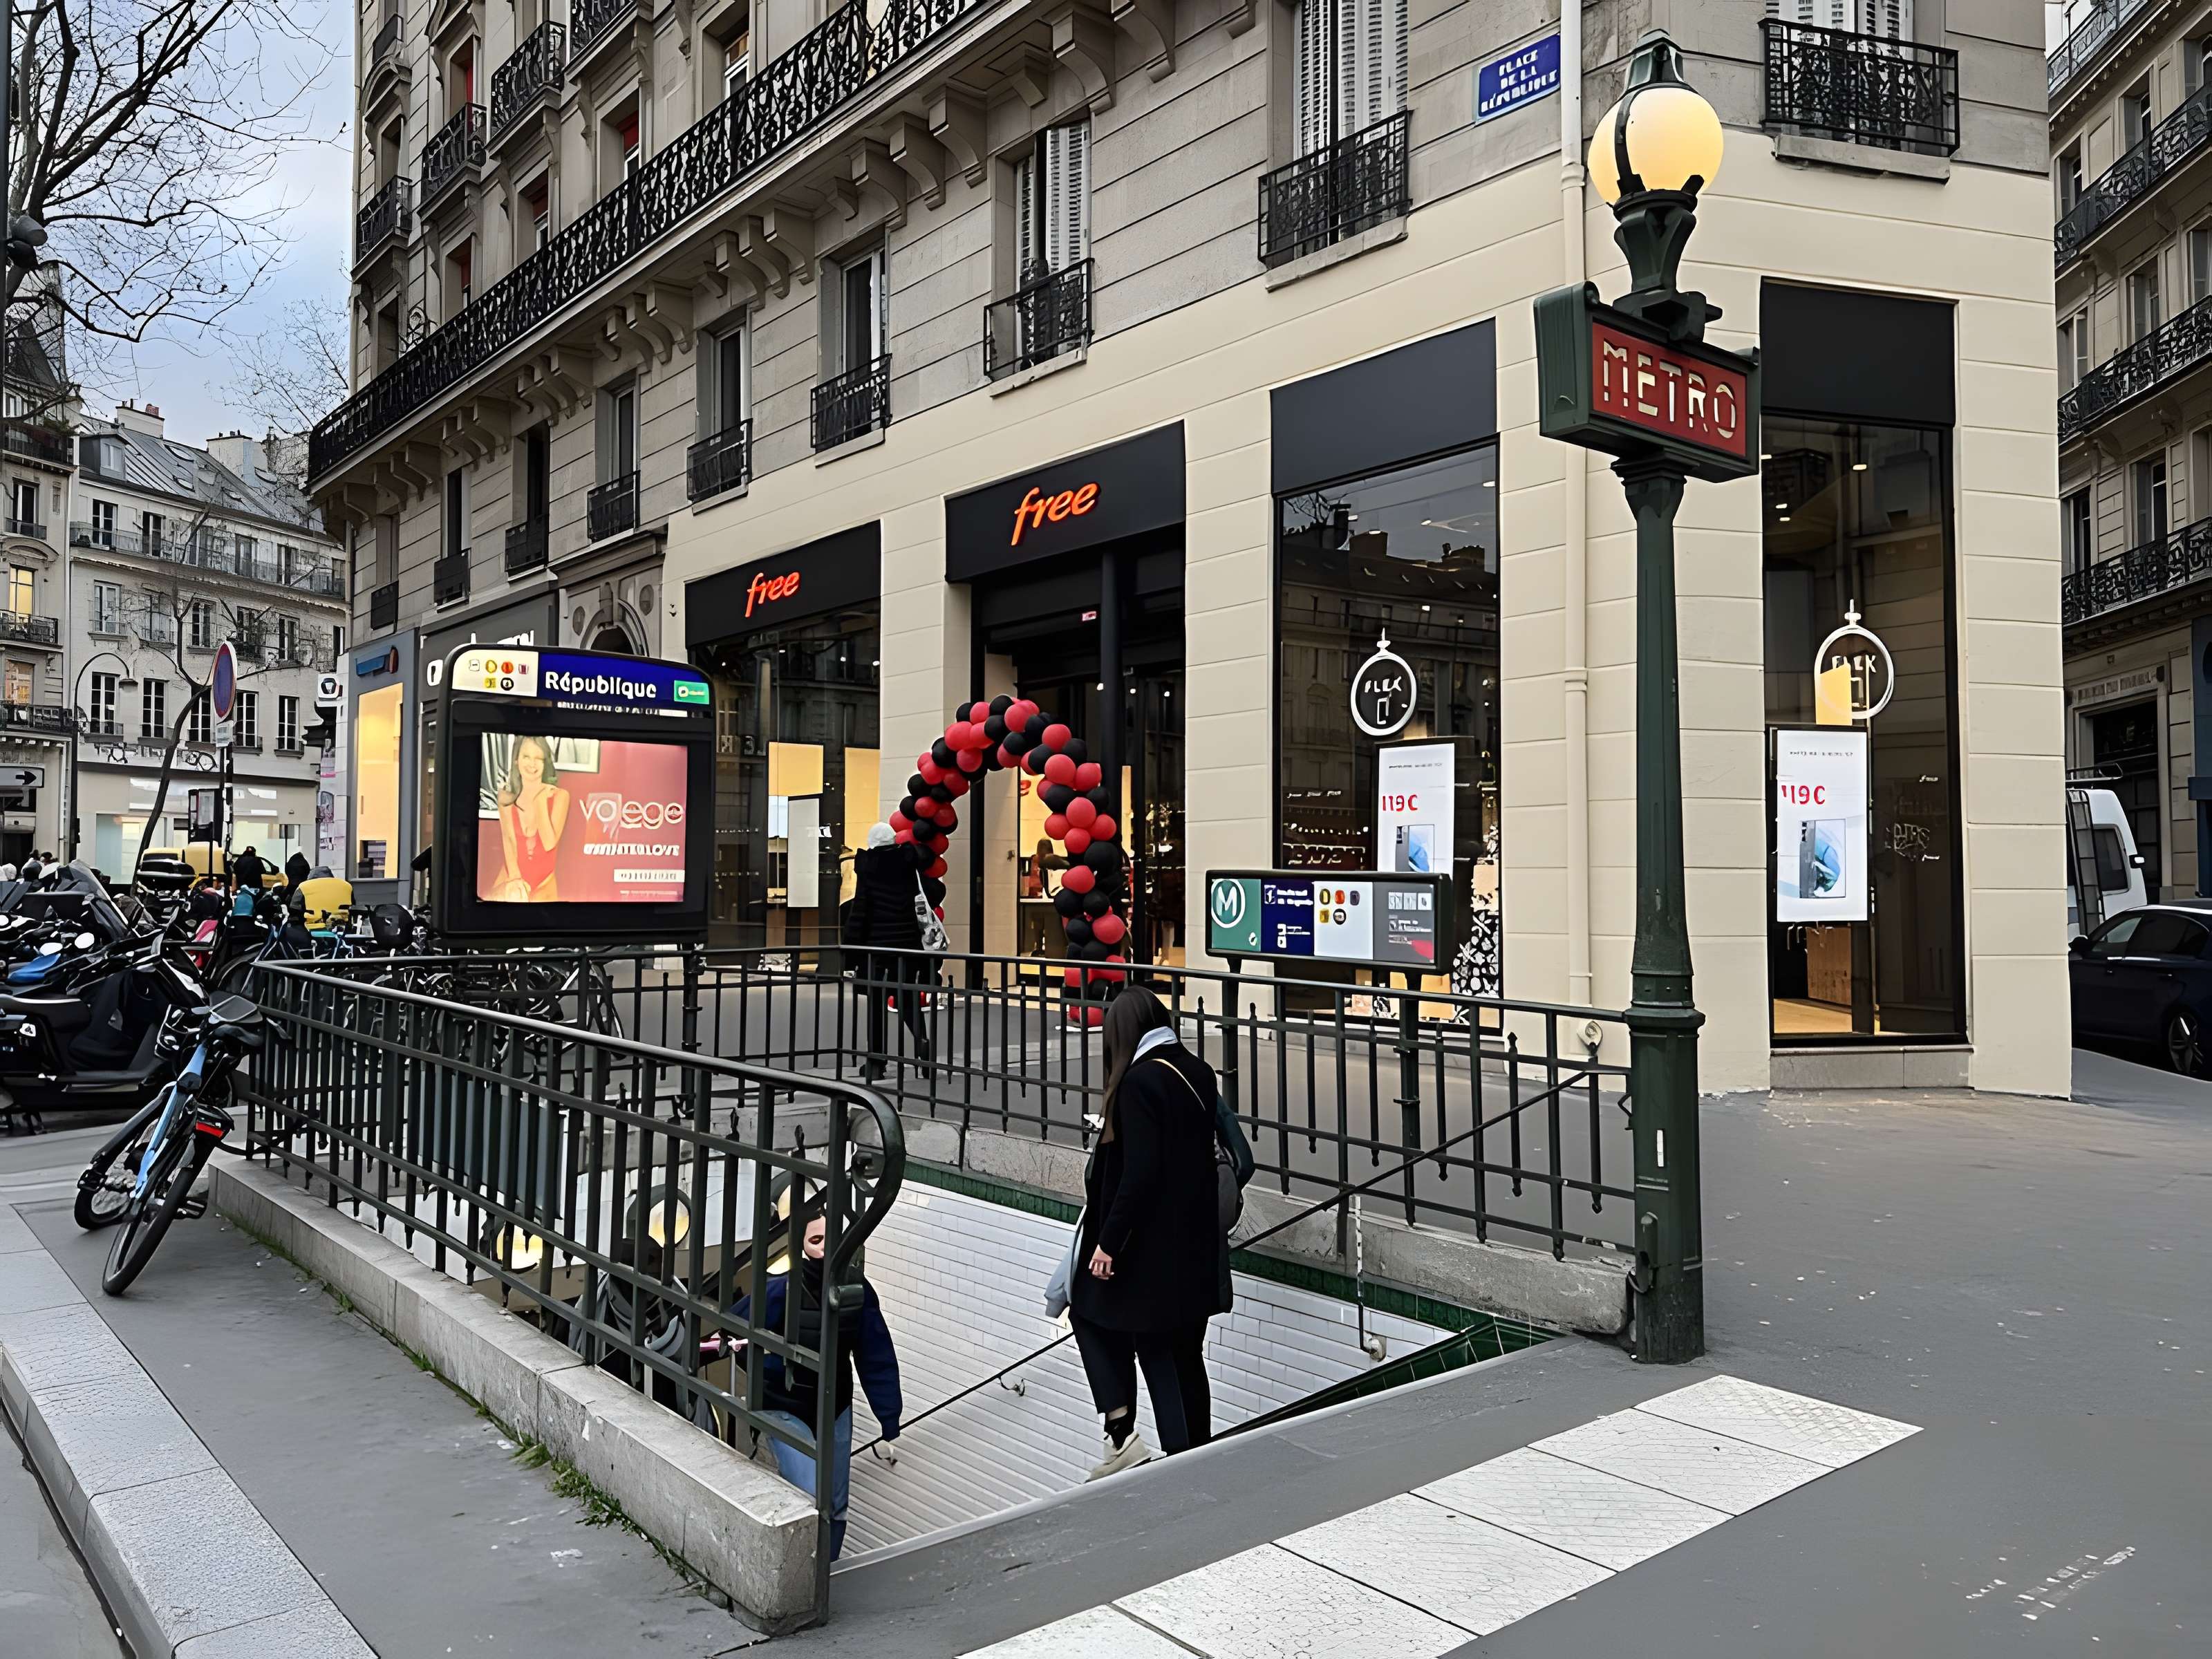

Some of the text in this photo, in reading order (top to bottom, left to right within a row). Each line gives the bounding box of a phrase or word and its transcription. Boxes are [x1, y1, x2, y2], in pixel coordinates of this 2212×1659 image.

[1603, 337, 1737, 440] METRO
[1011, 482, 1098, 547] free
[744, 572, 800, 618] free
[545, 671, 657, 700] République
